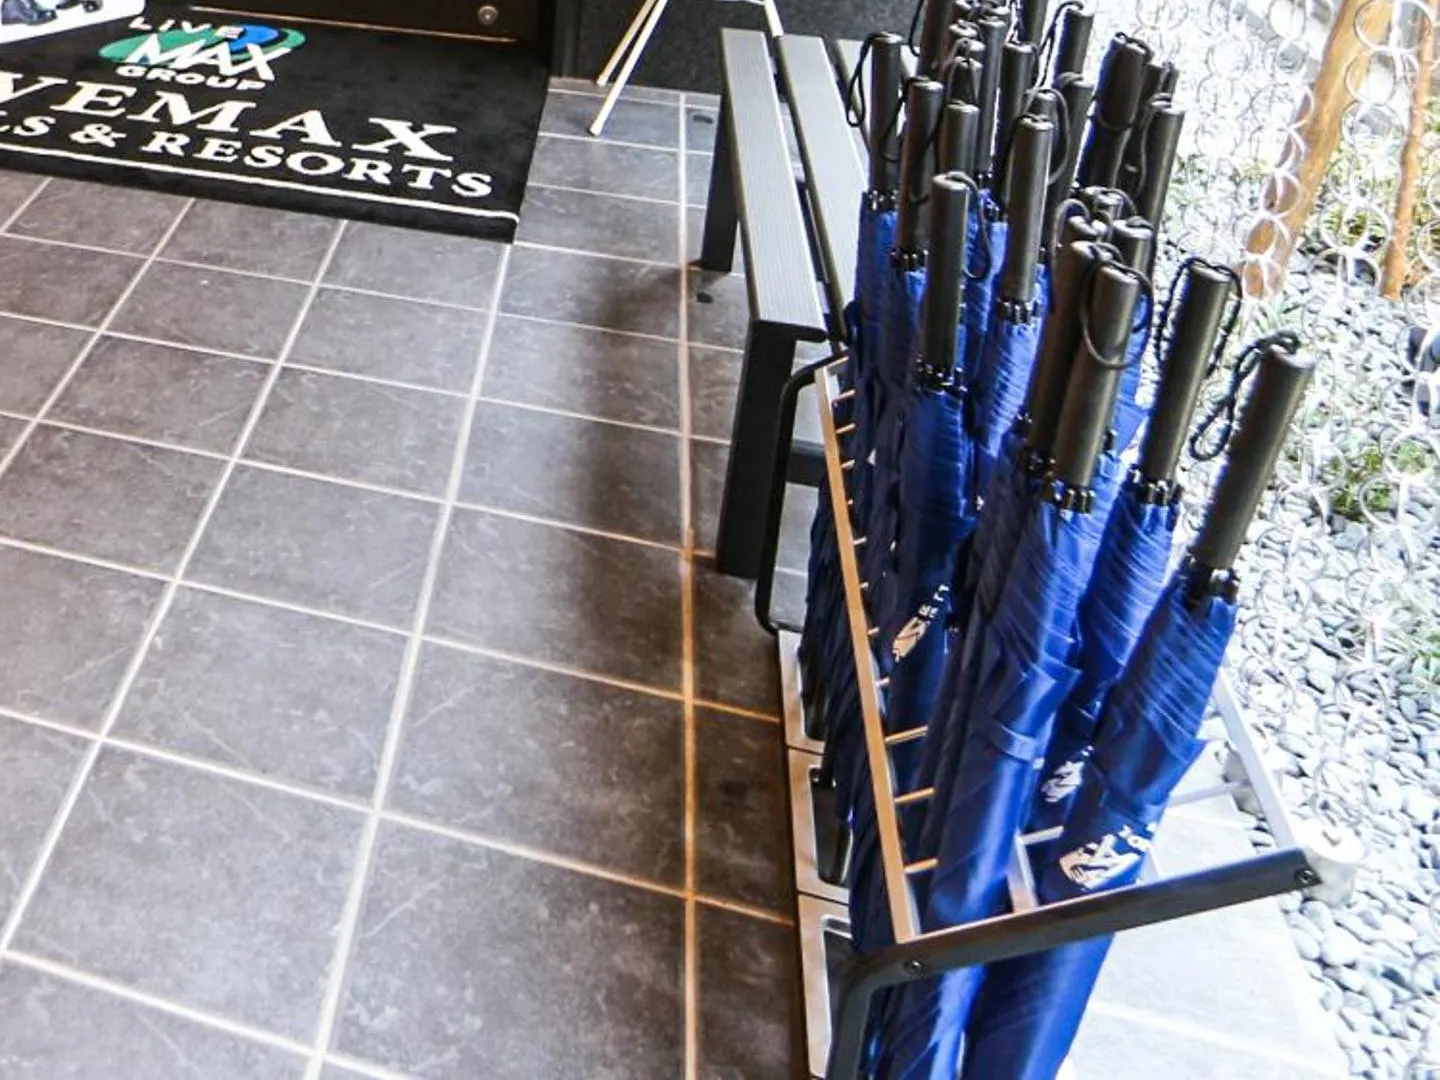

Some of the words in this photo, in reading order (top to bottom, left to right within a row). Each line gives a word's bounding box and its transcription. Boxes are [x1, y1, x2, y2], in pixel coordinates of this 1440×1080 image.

[116, 64, 267, 90] GROUP
[125, 33, 292, 81] MAX
[68, 123, 128, 148] &
[139, 131, 493, 198] RESORTS
